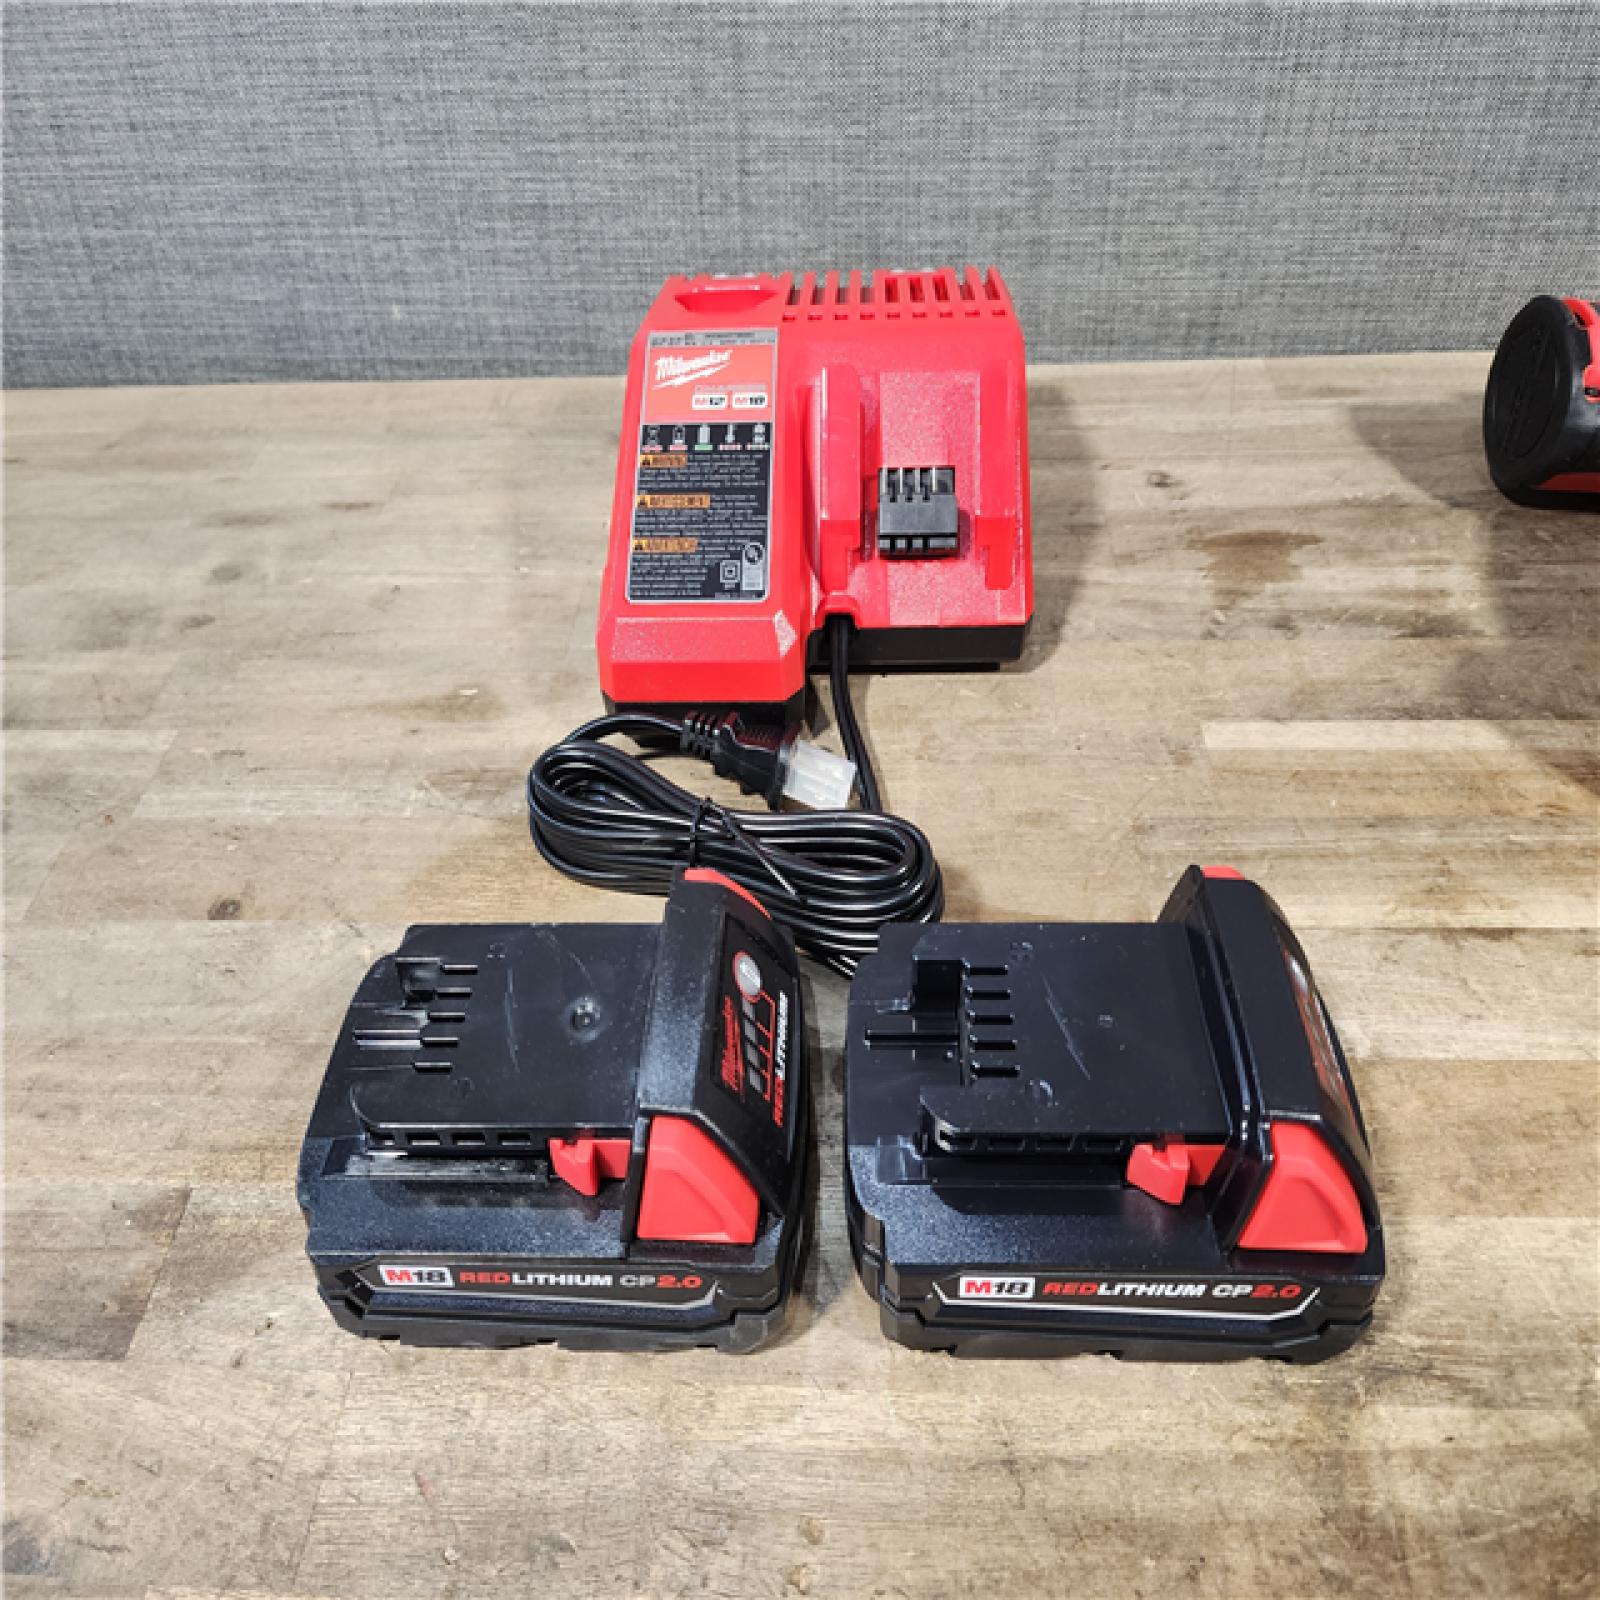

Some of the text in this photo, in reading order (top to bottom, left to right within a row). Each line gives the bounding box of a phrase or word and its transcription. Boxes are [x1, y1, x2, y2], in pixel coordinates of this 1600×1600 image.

[384, 1268, 703, 1289] M18 REDLITHIUM CP2.0
[964, 1279, 1302, 1299] M18 REDLITHIUM CP2.0
